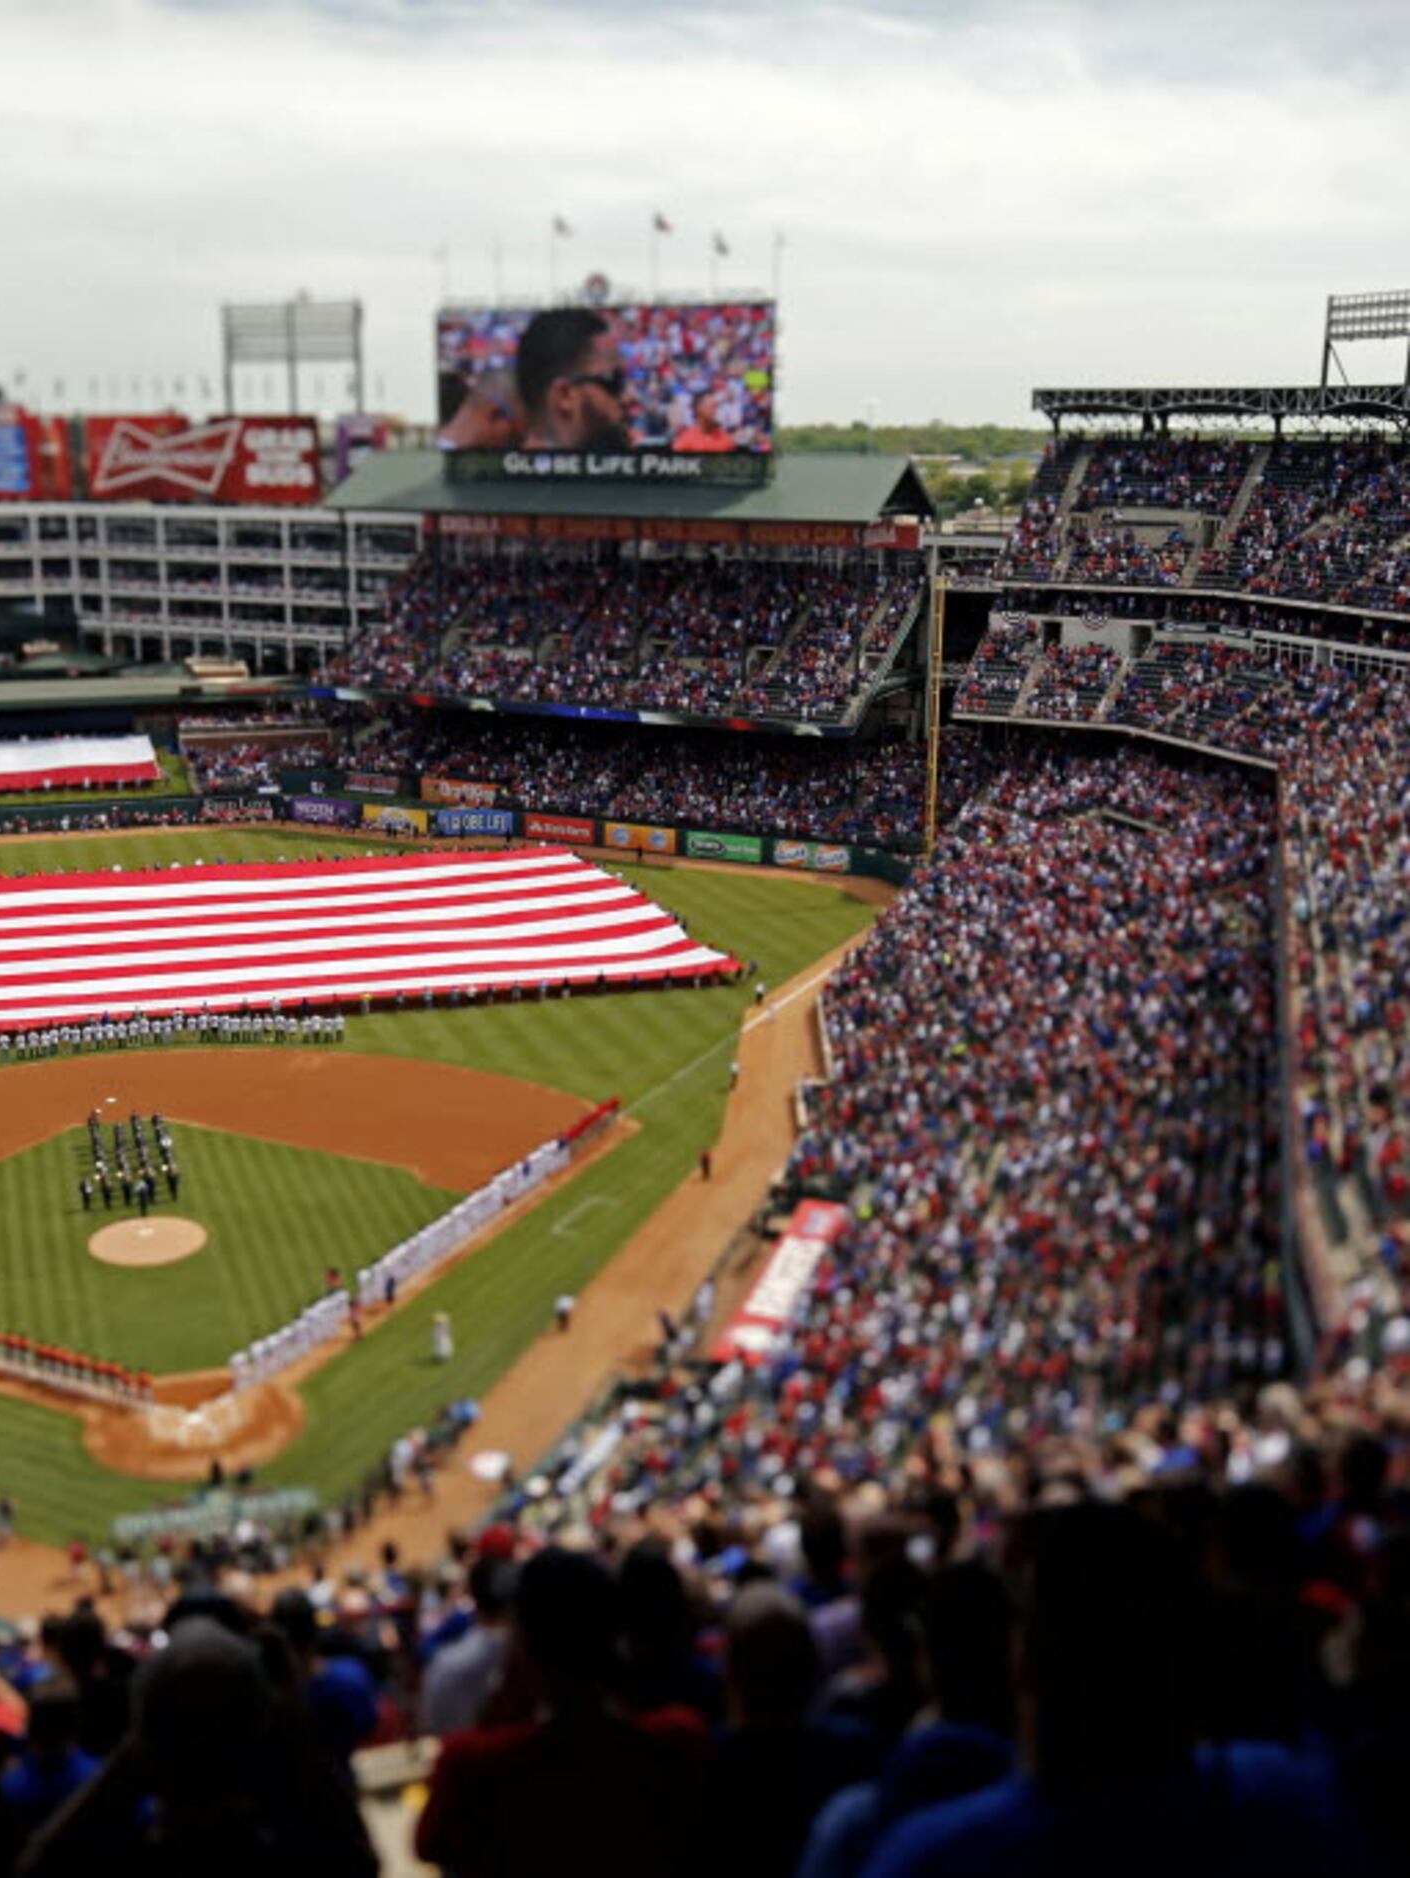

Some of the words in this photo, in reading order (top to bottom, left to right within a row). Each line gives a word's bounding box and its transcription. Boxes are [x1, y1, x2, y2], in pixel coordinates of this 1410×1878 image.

[503, 452, 580, 475] GLOBE
[586, 453, 637, 475] LIFE
[641, 453, 702, 475] PARK
